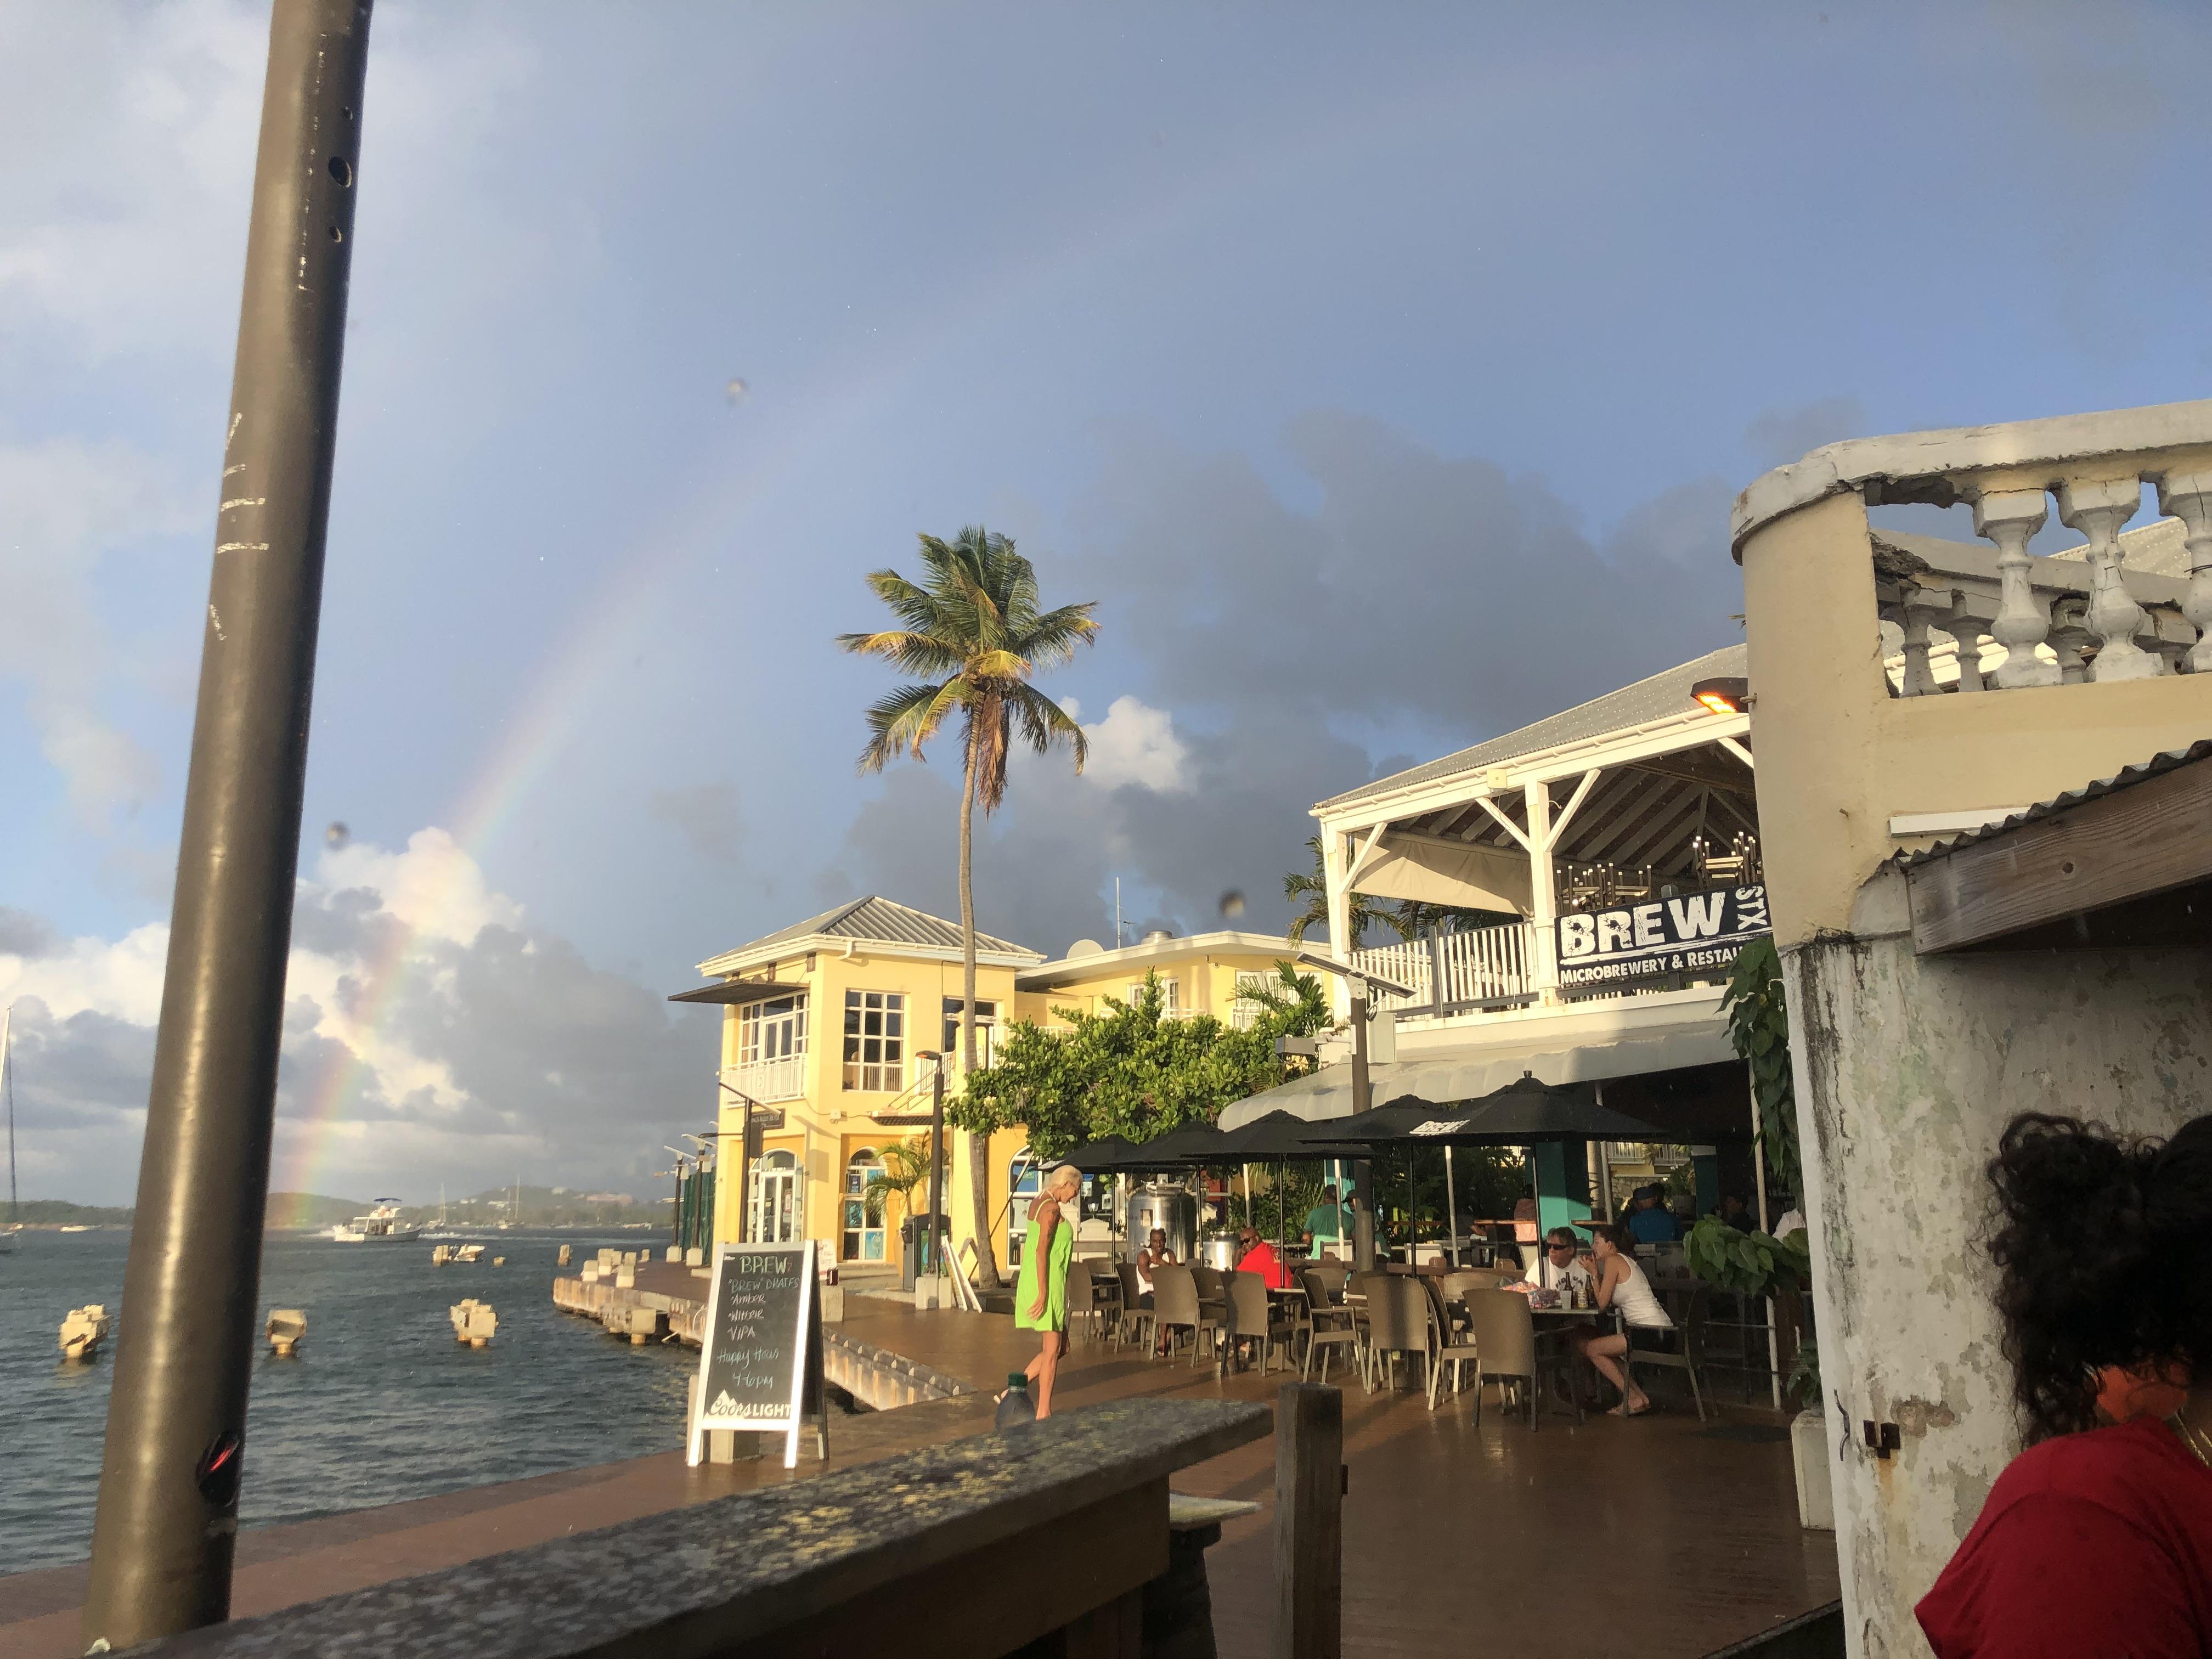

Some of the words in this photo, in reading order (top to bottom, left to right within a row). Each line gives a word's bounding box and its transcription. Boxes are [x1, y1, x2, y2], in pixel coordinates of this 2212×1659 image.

[1561, 891, 1726, 958] BREW
[1735, 885, 1768, 930] STX
[1560, 957, 1667, 984] MICROBREWERY
[1672, 954, 1684, 969] &
[1413, 1121, 1461, 1132] BREW
[739, 1255, 787, 1274] BREW
[752, 1403, 791, 1418] LIGHT
